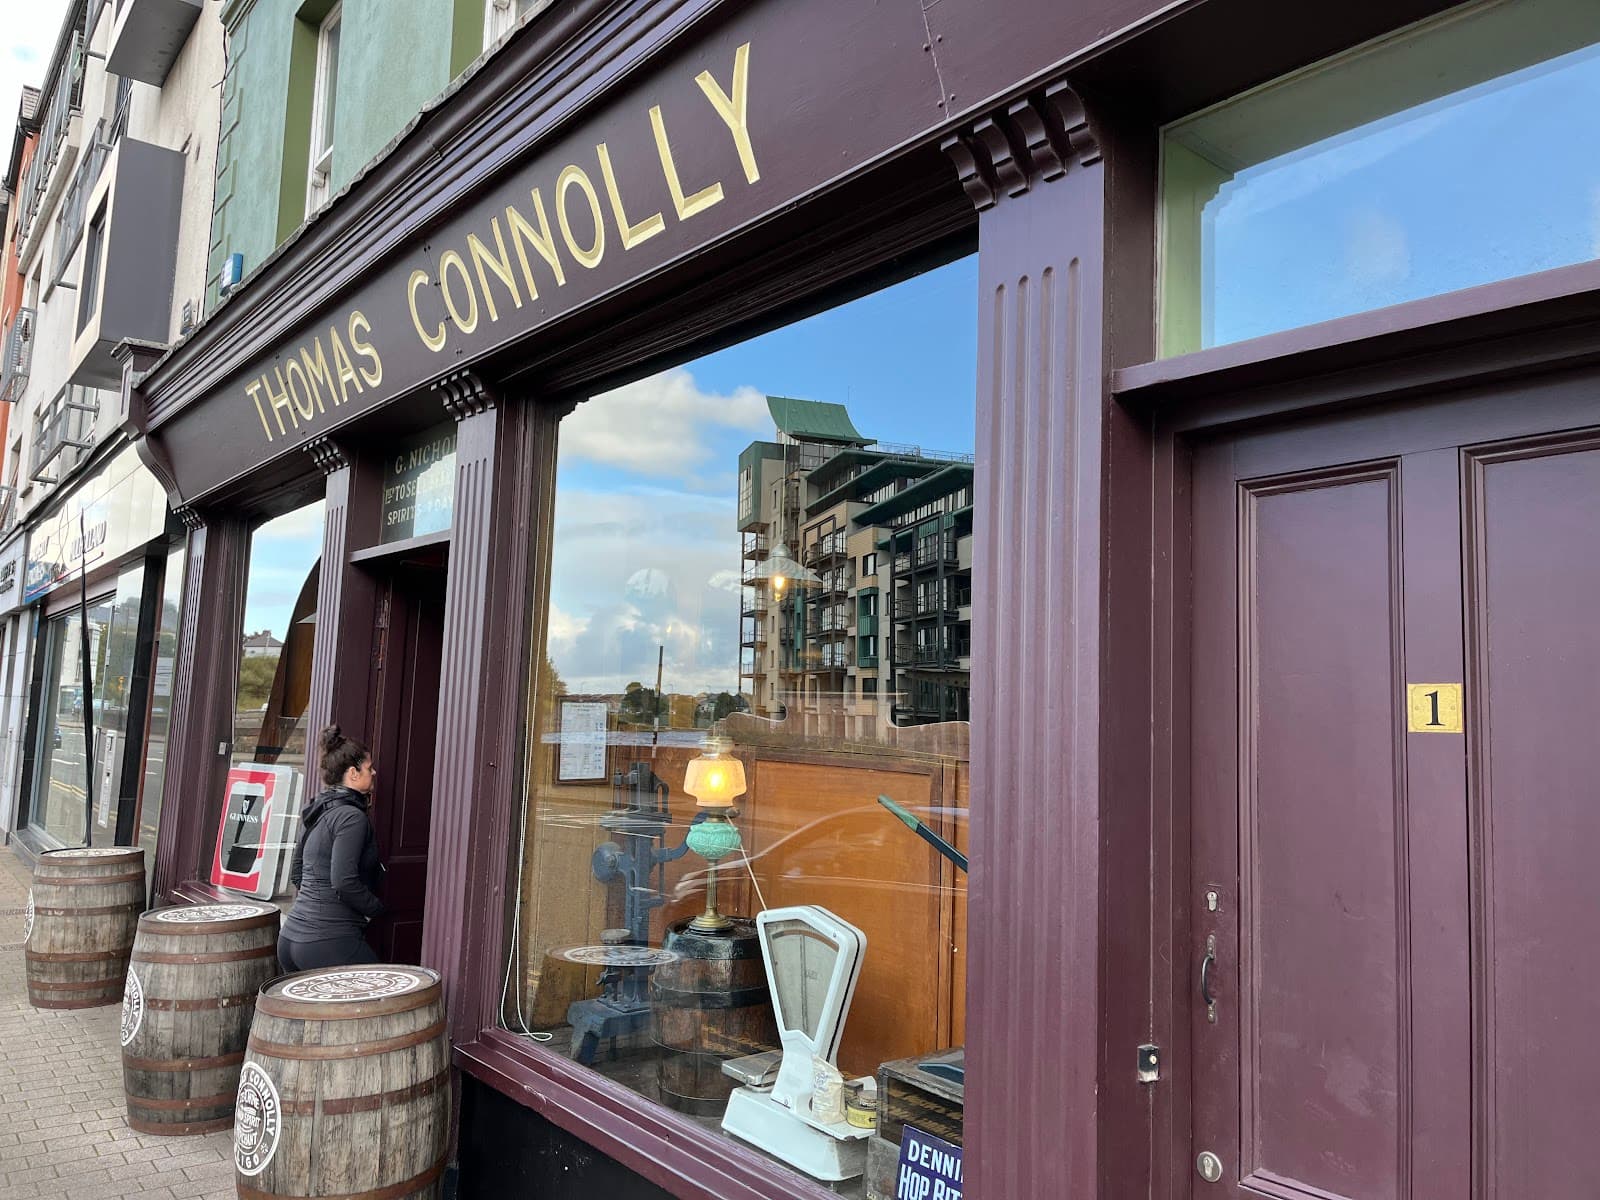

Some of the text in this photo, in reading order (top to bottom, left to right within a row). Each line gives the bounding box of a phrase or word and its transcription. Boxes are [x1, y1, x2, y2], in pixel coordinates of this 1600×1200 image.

[246, 42, 760, 442] THOMAS CONNOLLY
[1425, 691, 1446, 726] 1
[250, 1070, 275, 1137] CONNOLLY
[907, 1138, 963, 1183] DENNI
